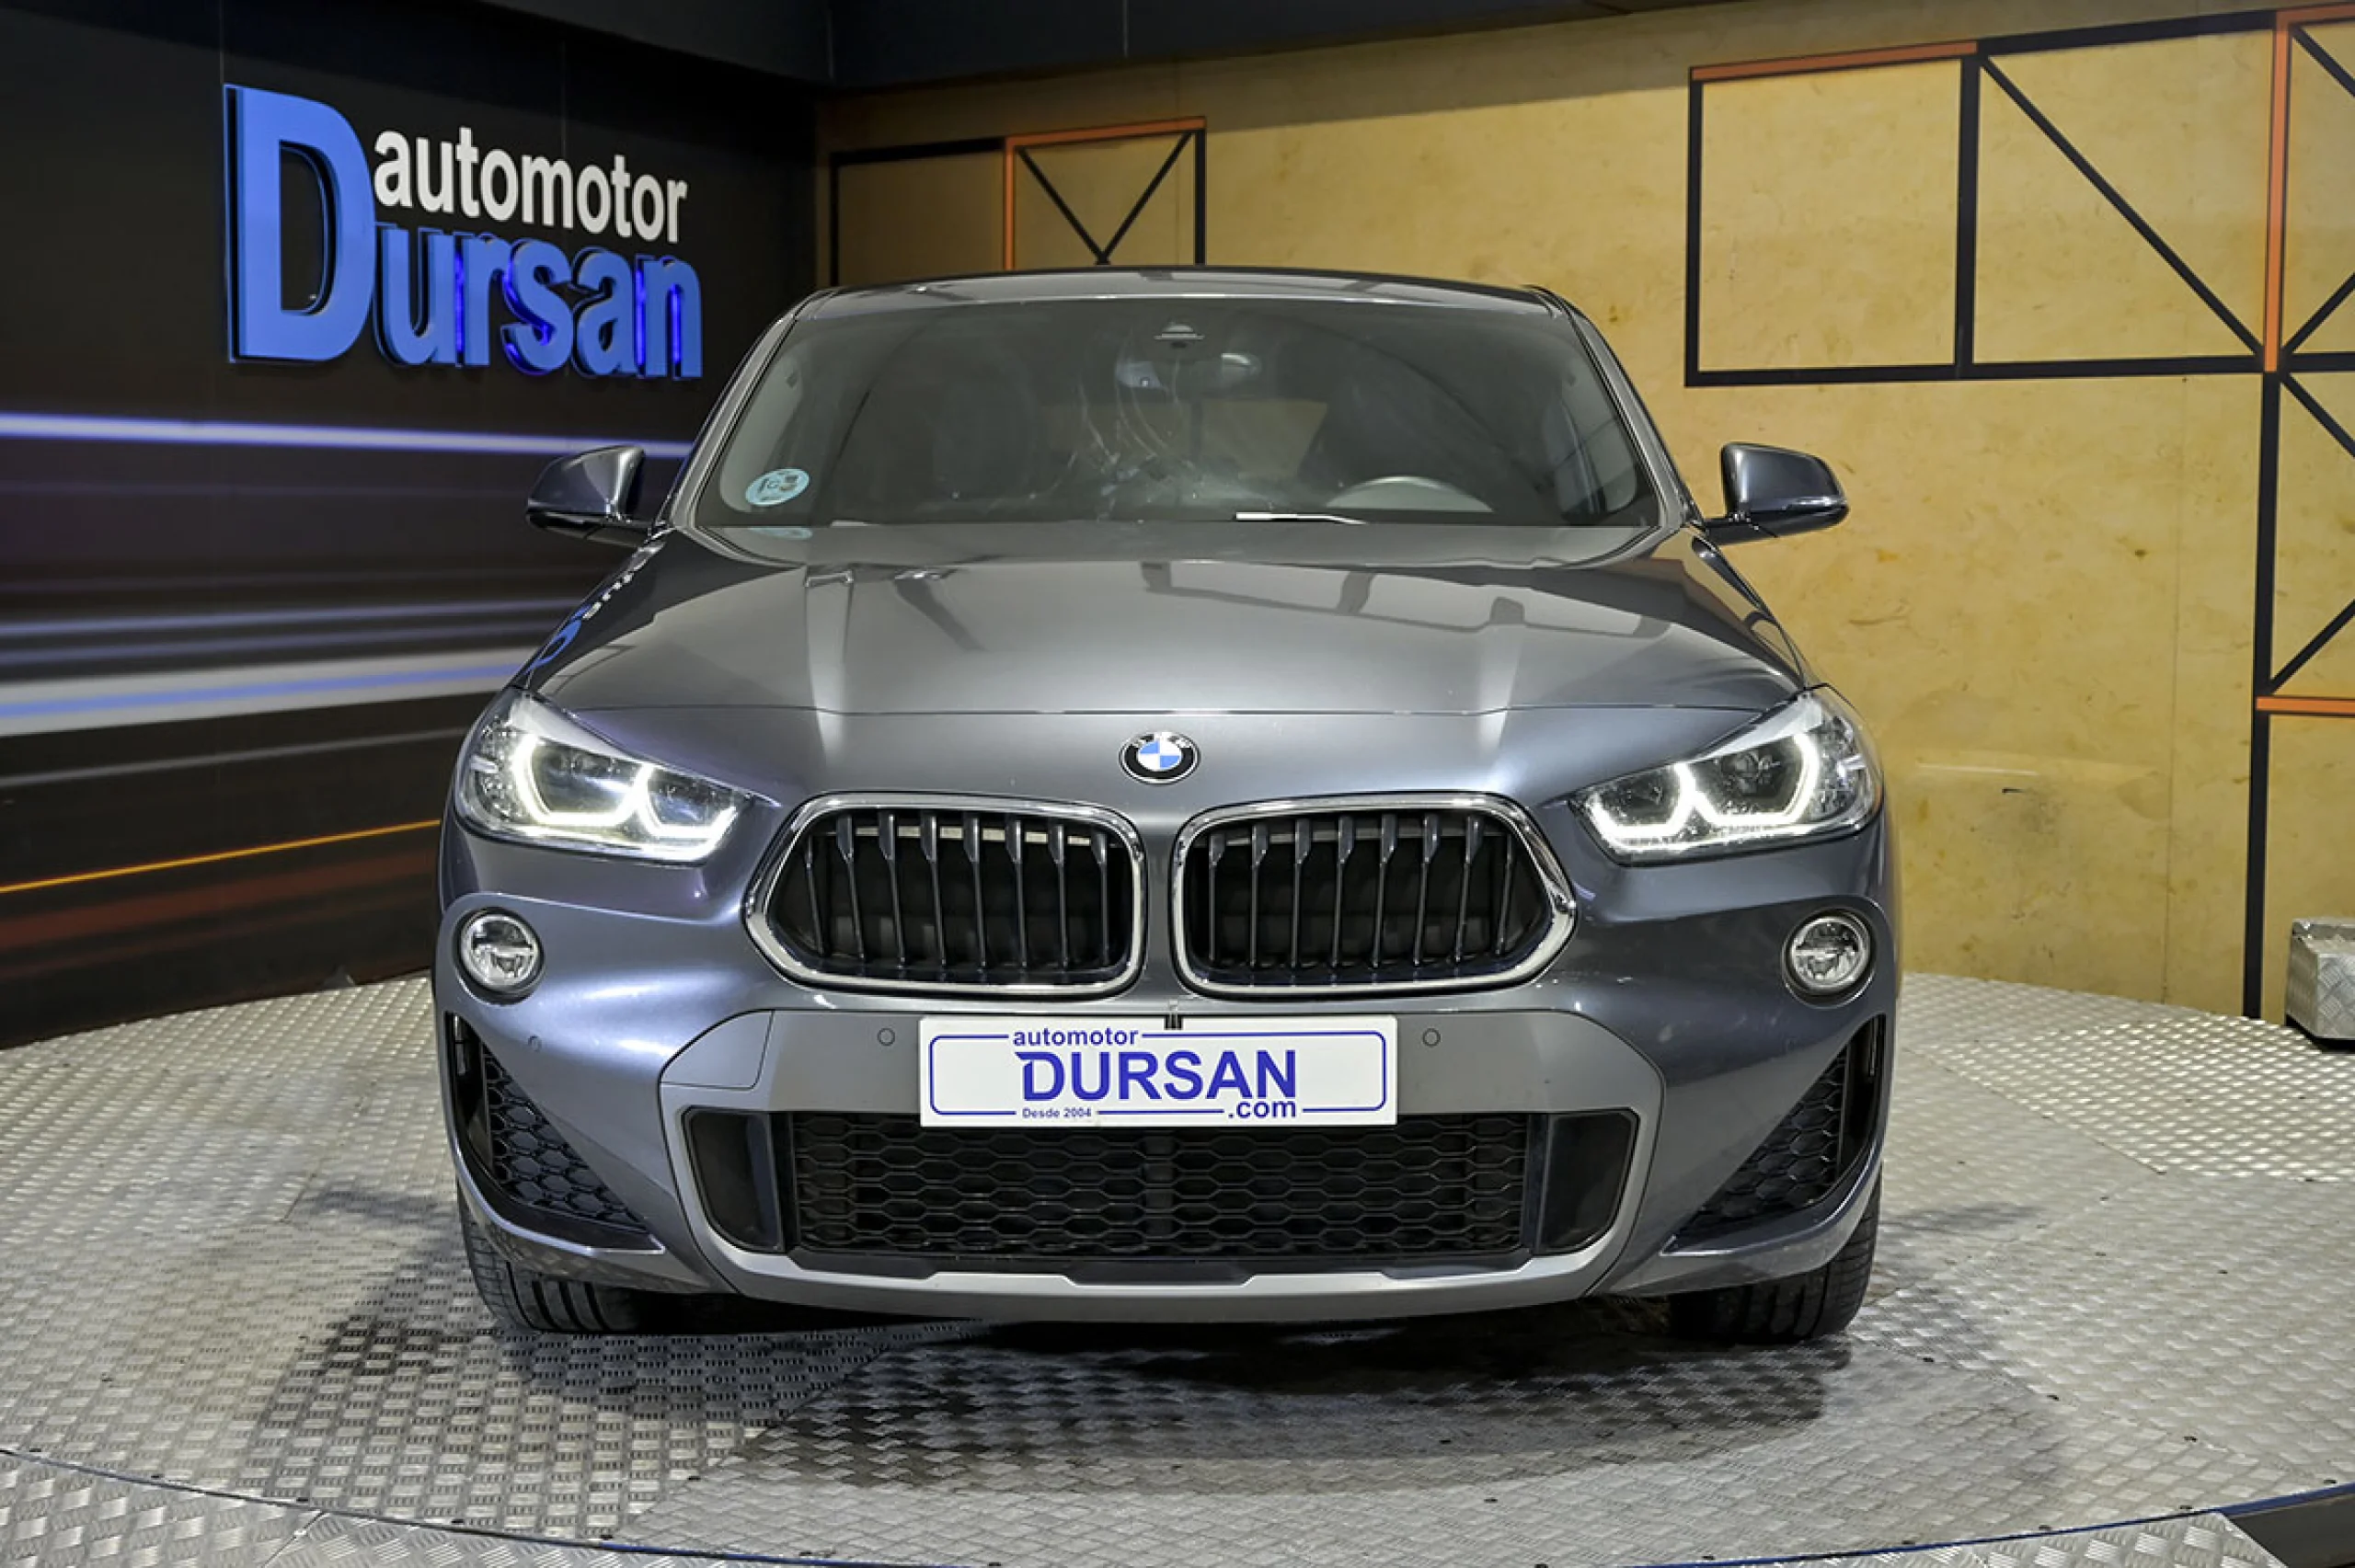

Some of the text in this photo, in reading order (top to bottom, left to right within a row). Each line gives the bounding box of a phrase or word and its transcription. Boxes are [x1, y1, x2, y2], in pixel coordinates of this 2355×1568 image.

[373, 127, 688, 244] automotor
[224, 84, 703, 380] Dursan
[1013, 1027, 1139, 1047] automotor
[1014, 1049, 1296, 1102] DURSAN
[1022, 1107, 1092, 1118] Desde 2004
[1227, 1100, 1297, 1119] .com
